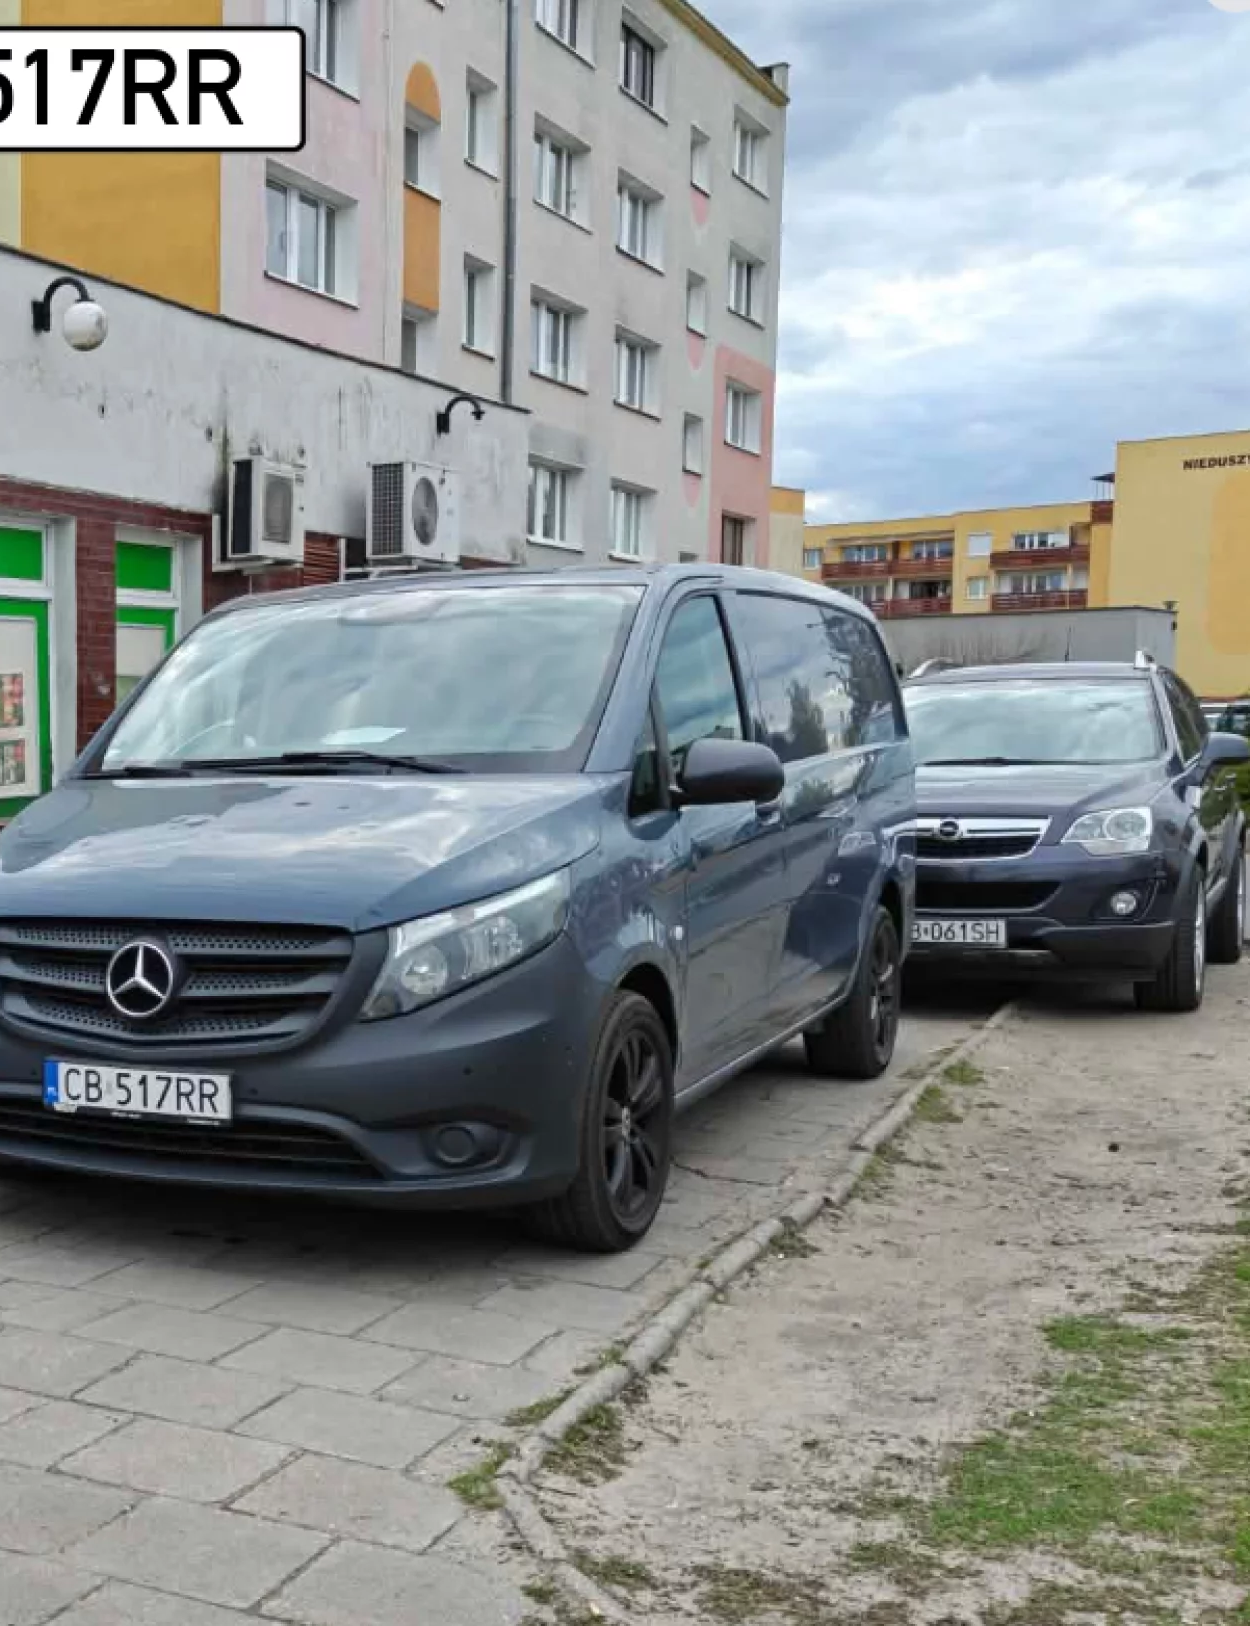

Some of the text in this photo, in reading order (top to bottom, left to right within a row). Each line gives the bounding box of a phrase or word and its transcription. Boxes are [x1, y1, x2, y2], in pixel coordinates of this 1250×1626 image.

[931, 922, 999, 941] 061SH
[64, 1068, 220, 1114] CB 517RR
